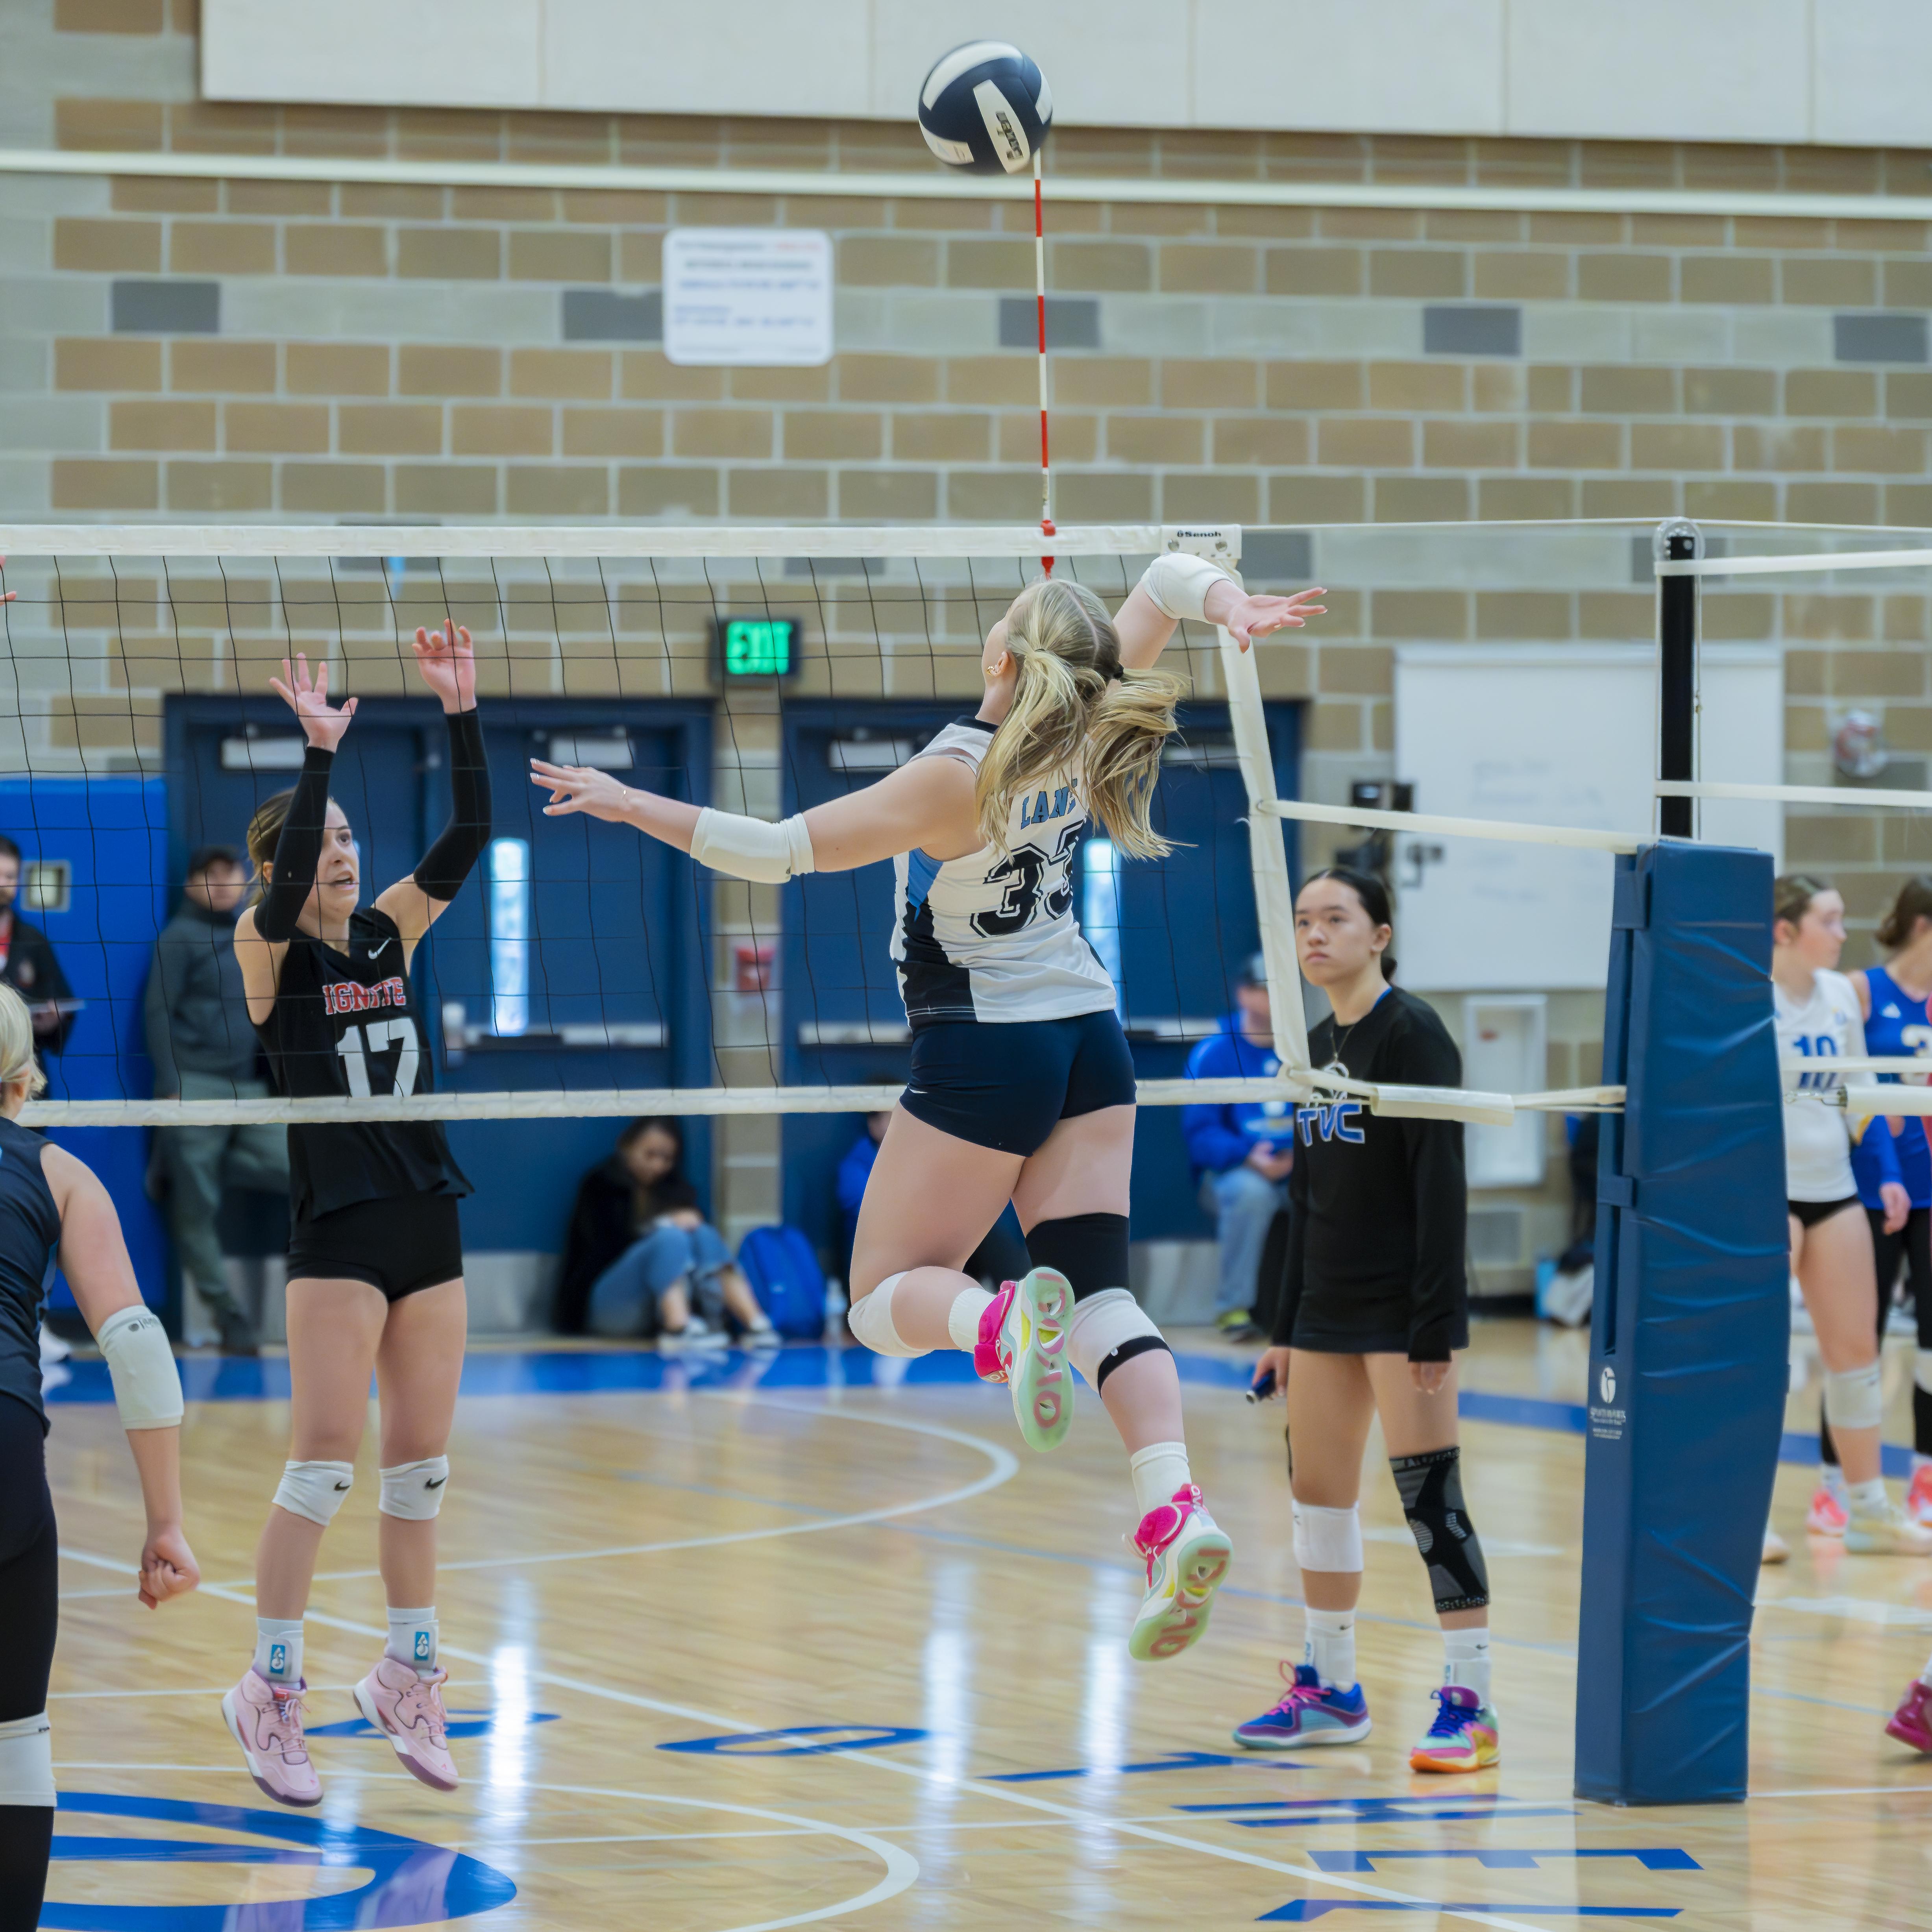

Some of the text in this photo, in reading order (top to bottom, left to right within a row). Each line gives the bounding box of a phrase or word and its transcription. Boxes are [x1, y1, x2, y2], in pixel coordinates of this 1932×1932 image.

[322, 976, 407, 1015] IGNITE
[335, 1017, 419, 1097] 17
[1296, 1103, 1366, 1147] TVC
